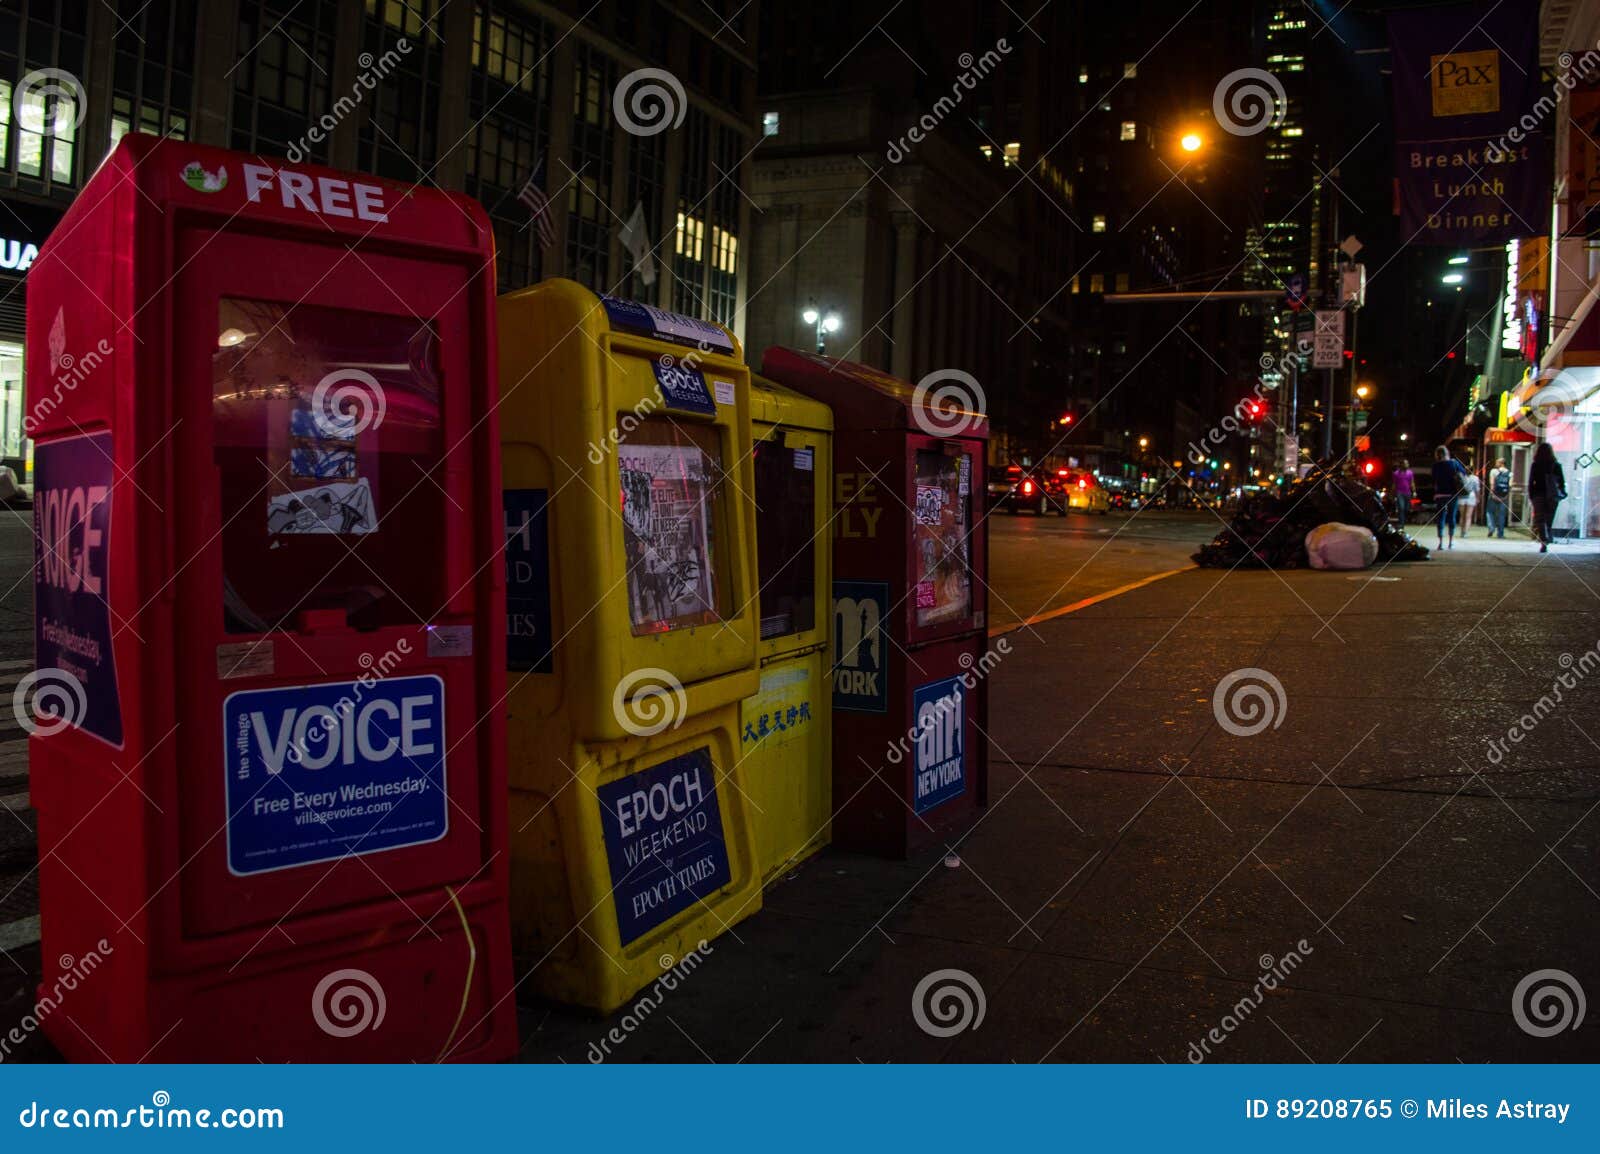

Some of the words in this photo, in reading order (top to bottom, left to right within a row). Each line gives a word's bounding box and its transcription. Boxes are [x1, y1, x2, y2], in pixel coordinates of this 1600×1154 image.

[1438, 61, 1492, 88] Pax
[1410, 145, 1529, 168] Breakfast
[243, 162, 389, 223] FREE
[1433, 178, 1504, 198] Lunch
[1426, 211, 1512, 229] Dinner
[660, 367, 703, 393] EPOCH
[618, 456, 647, 471] POCH
[834, 472, 877, 502] EE
[41, 485, 107, 593] VOICE
[236, 712, 251, 755] village
[251, 694, 434, 775] VOICE
[237, 756, 250, 780] the
[937, 756, 962, 788] YORK
[253, 797, 290, 816] Free
[294, 790, 338, 808] Every
[340, 777, 431, 802] Wednesday.
[616, 767, 704, 839] EPOCH
[295, 801, 393, 826] villagevoice.com
[623, 811, 708, 868] WEEKEND
[632, 874, 678, 920] EPOCH
[675, 854, 716, 891] TIMES
